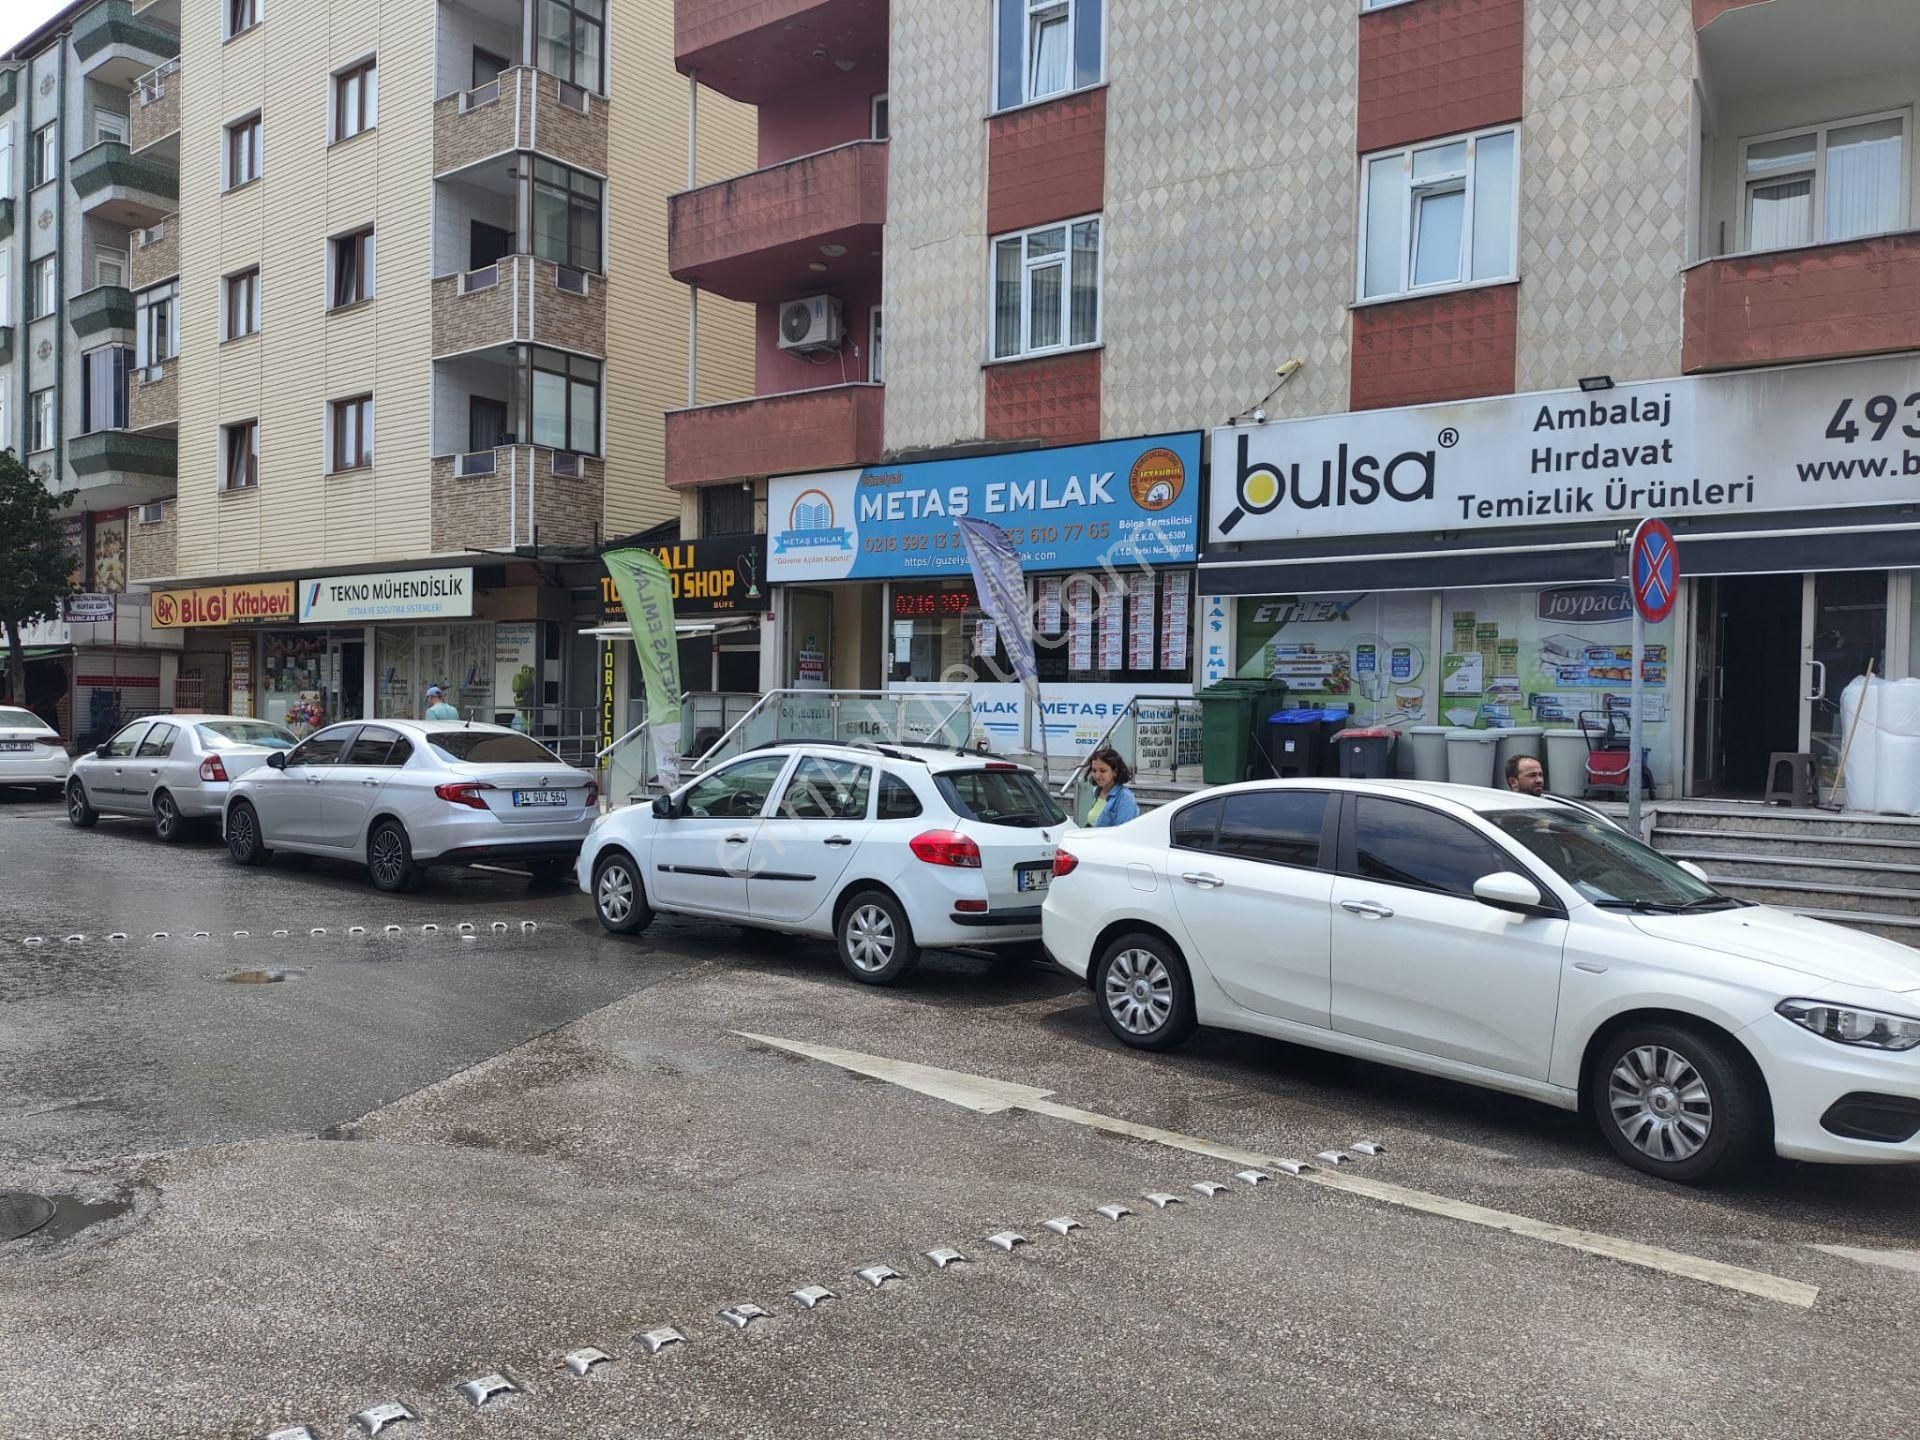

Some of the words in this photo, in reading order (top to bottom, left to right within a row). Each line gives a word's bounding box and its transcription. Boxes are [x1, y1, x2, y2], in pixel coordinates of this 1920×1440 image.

[1533, 393, 1672, 432] Ambalaj
[1531, 438, 1674, 474] Hırdavat
[1234, 433, 1435, 518] bulsa
[984, 471, 1116, 514] EMLAK
[1458, 487, 1594, 521] Temizlik
[1605, 475, 1755, 511] Ürünleri
[1119, 519, 1145, 530] Bölge
[1146, 514, 1193, 527] Temsilcisi
[814, 535, 843, 544] EMLAK
[864, 535, 897, 553] 0216
[903, 535, 928, 551] 392
[932, 533, 947, 549] 13
[1028, 525, 1057, 543] 610
[1063, 524, 1083, 541] 77
[1087, 521, 1111, 540] 65
[330, 584, 369, 602] TEKNO
[372, 574, 464, 600] MÜHENDİSLİK
[684, 569, 735, 598] SHOP
[158, 598, 173, 621] BK
[180, 588, 227, 623] BİLGİ
[232, 587, 290, 615] Kitabevi
[1252, 600, 1354, 623] ETHEX
[1545, 591, 1633, 616] joypack
[1041, 702, 1107, 719] METAŞ
[519, 792, 530, 802] 34
[550, 790, 566, 802] 564
[1025, 871, 1035, 886] 34
